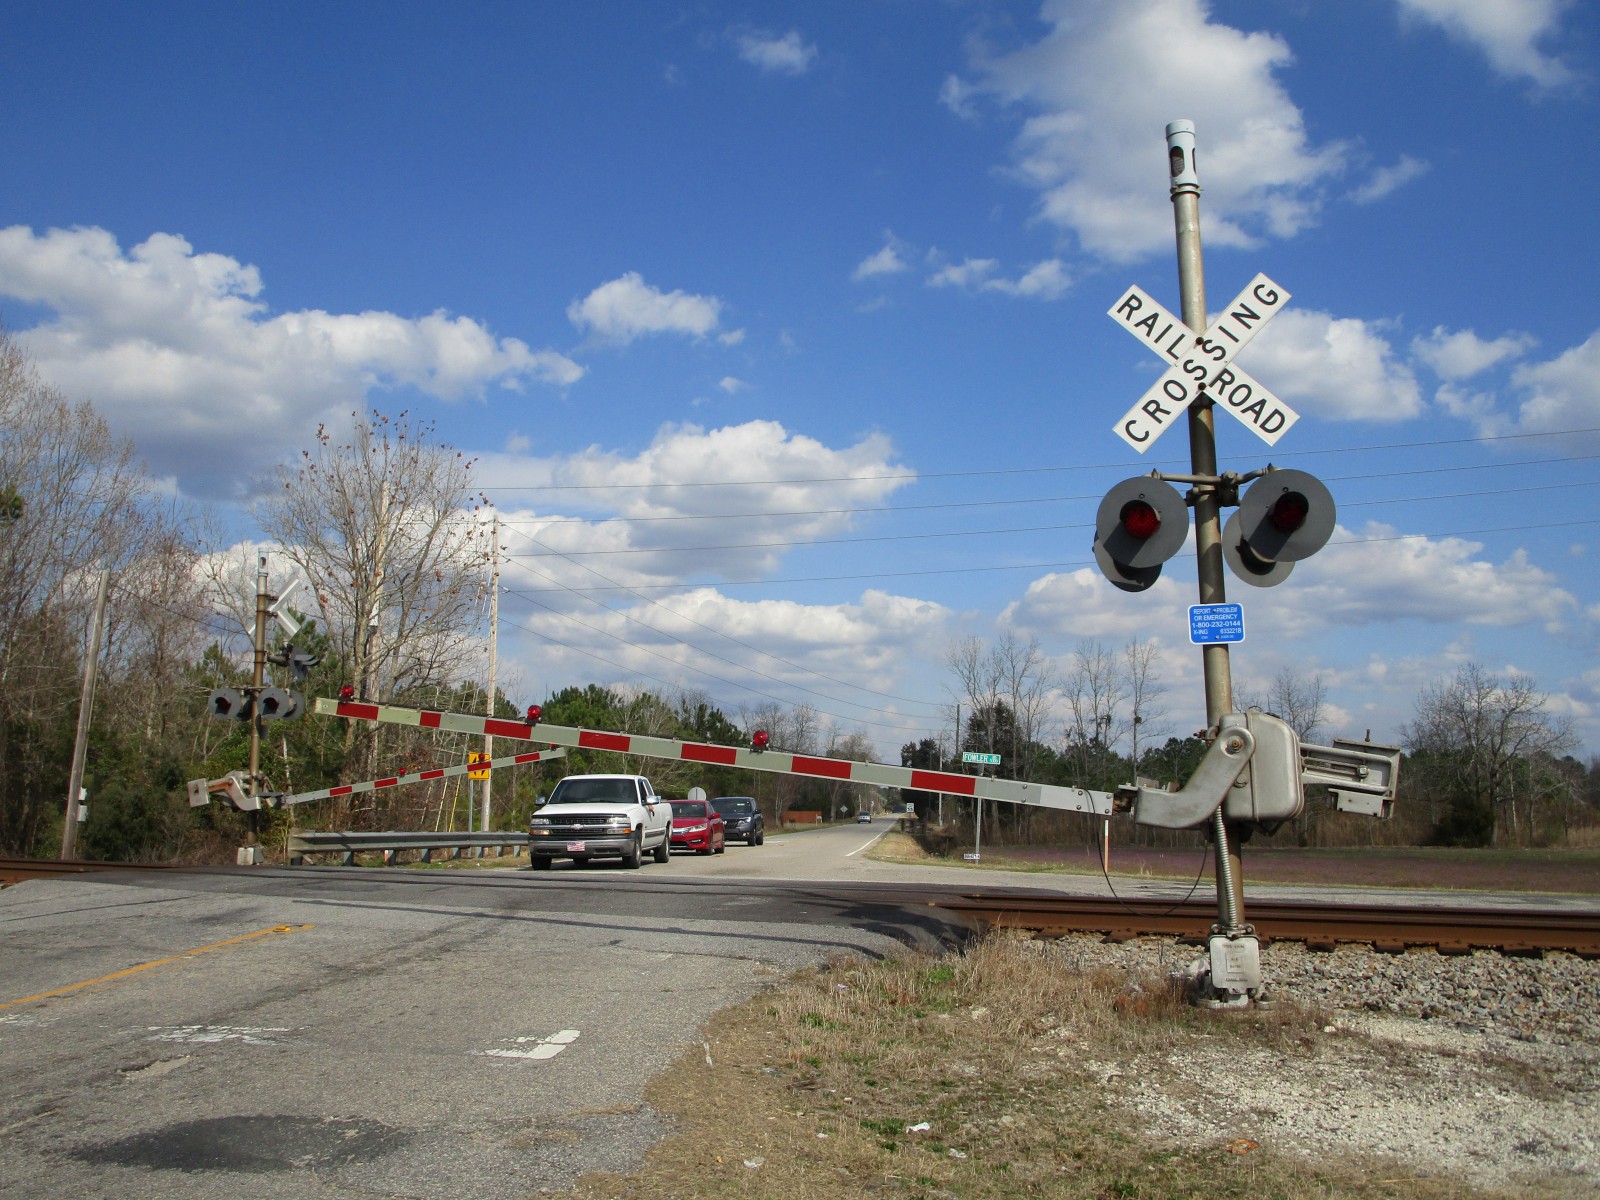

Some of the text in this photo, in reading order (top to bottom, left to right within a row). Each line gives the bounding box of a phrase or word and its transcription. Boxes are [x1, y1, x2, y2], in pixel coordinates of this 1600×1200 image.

[1116, 293, 1286, 434] RAIL ROAD
[1125, 283, 1279, 442] CROSSING
[964, 753, 988, 762] FOWLER
